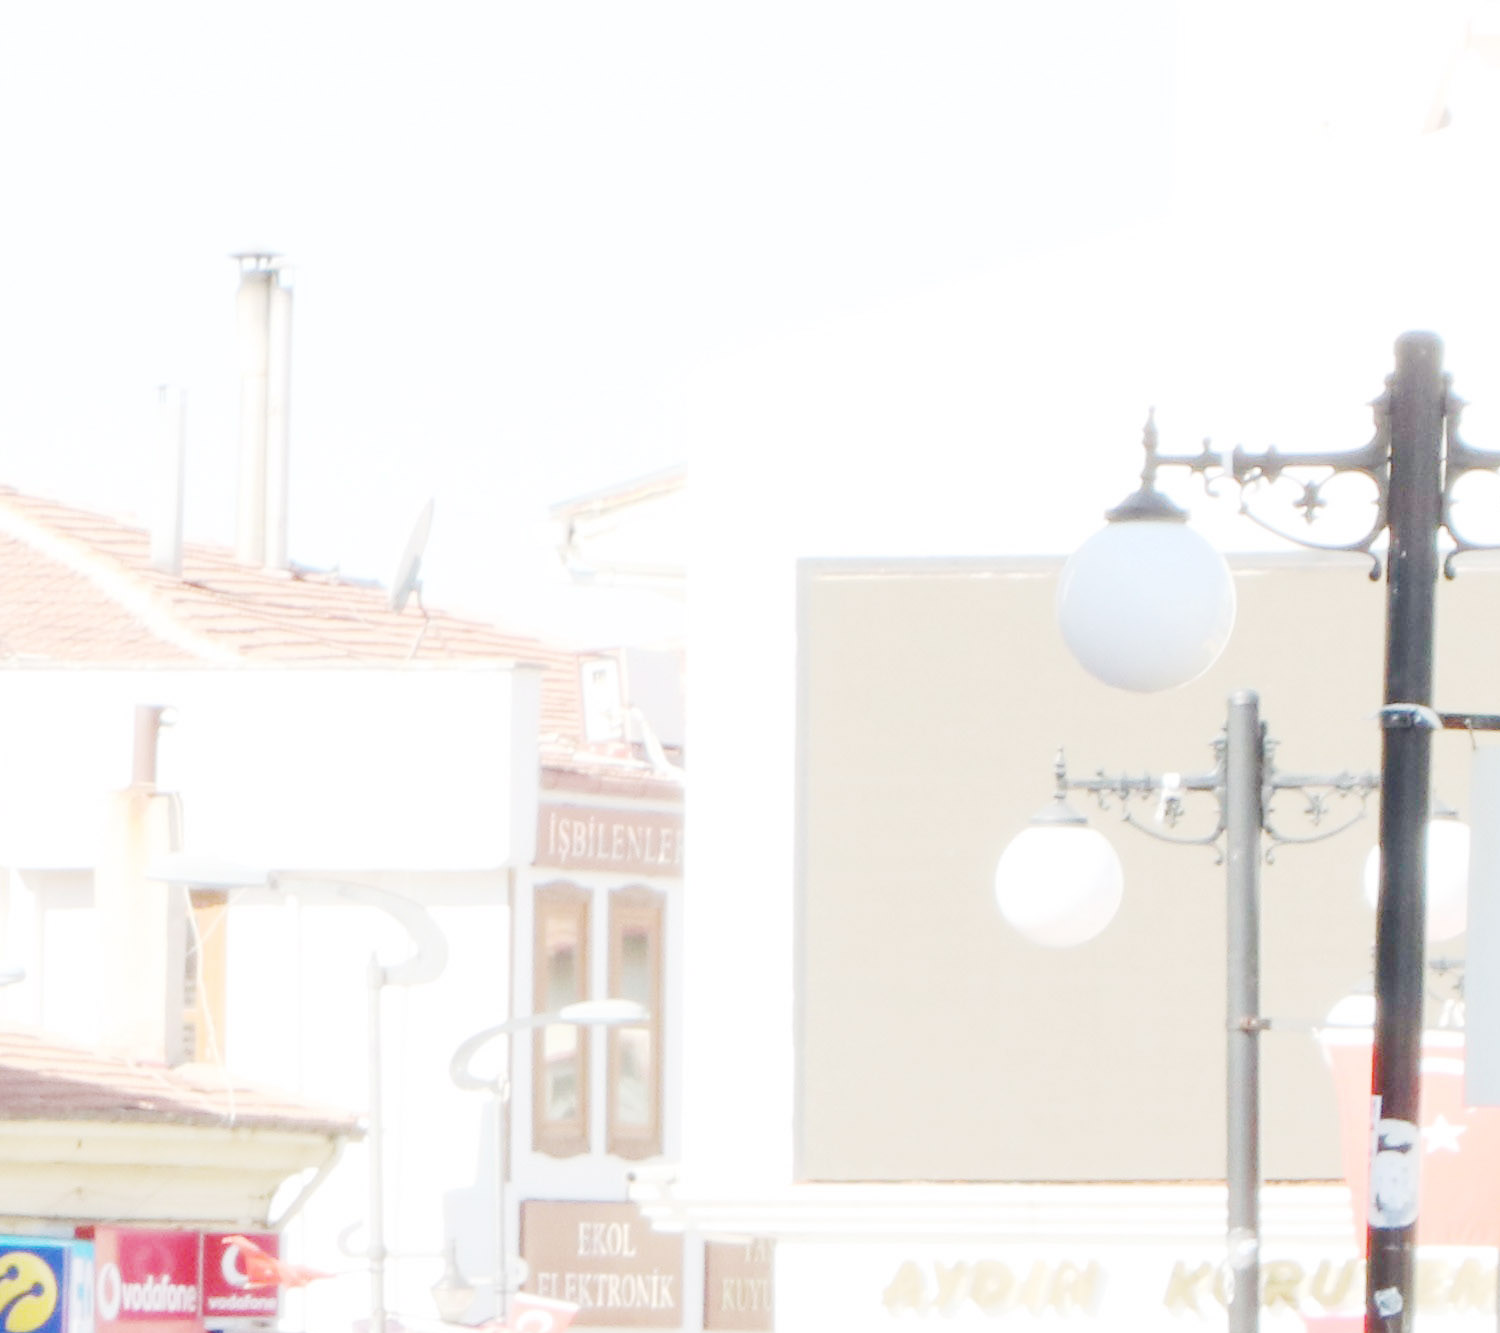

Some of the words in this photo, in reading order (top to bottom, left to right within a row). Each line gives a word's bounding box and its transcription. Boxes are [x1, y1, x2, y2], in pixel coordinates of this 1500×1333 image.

[576, 1221, 637, 1257] EKOL
[122, 1274, 198, 1312] vodafone
[208, 1295, 278, 1311] vodafone
[537, 1264, 676, 1310] ELEKTRONİK
[880, 1257, 1106, 1317] AYDIN
